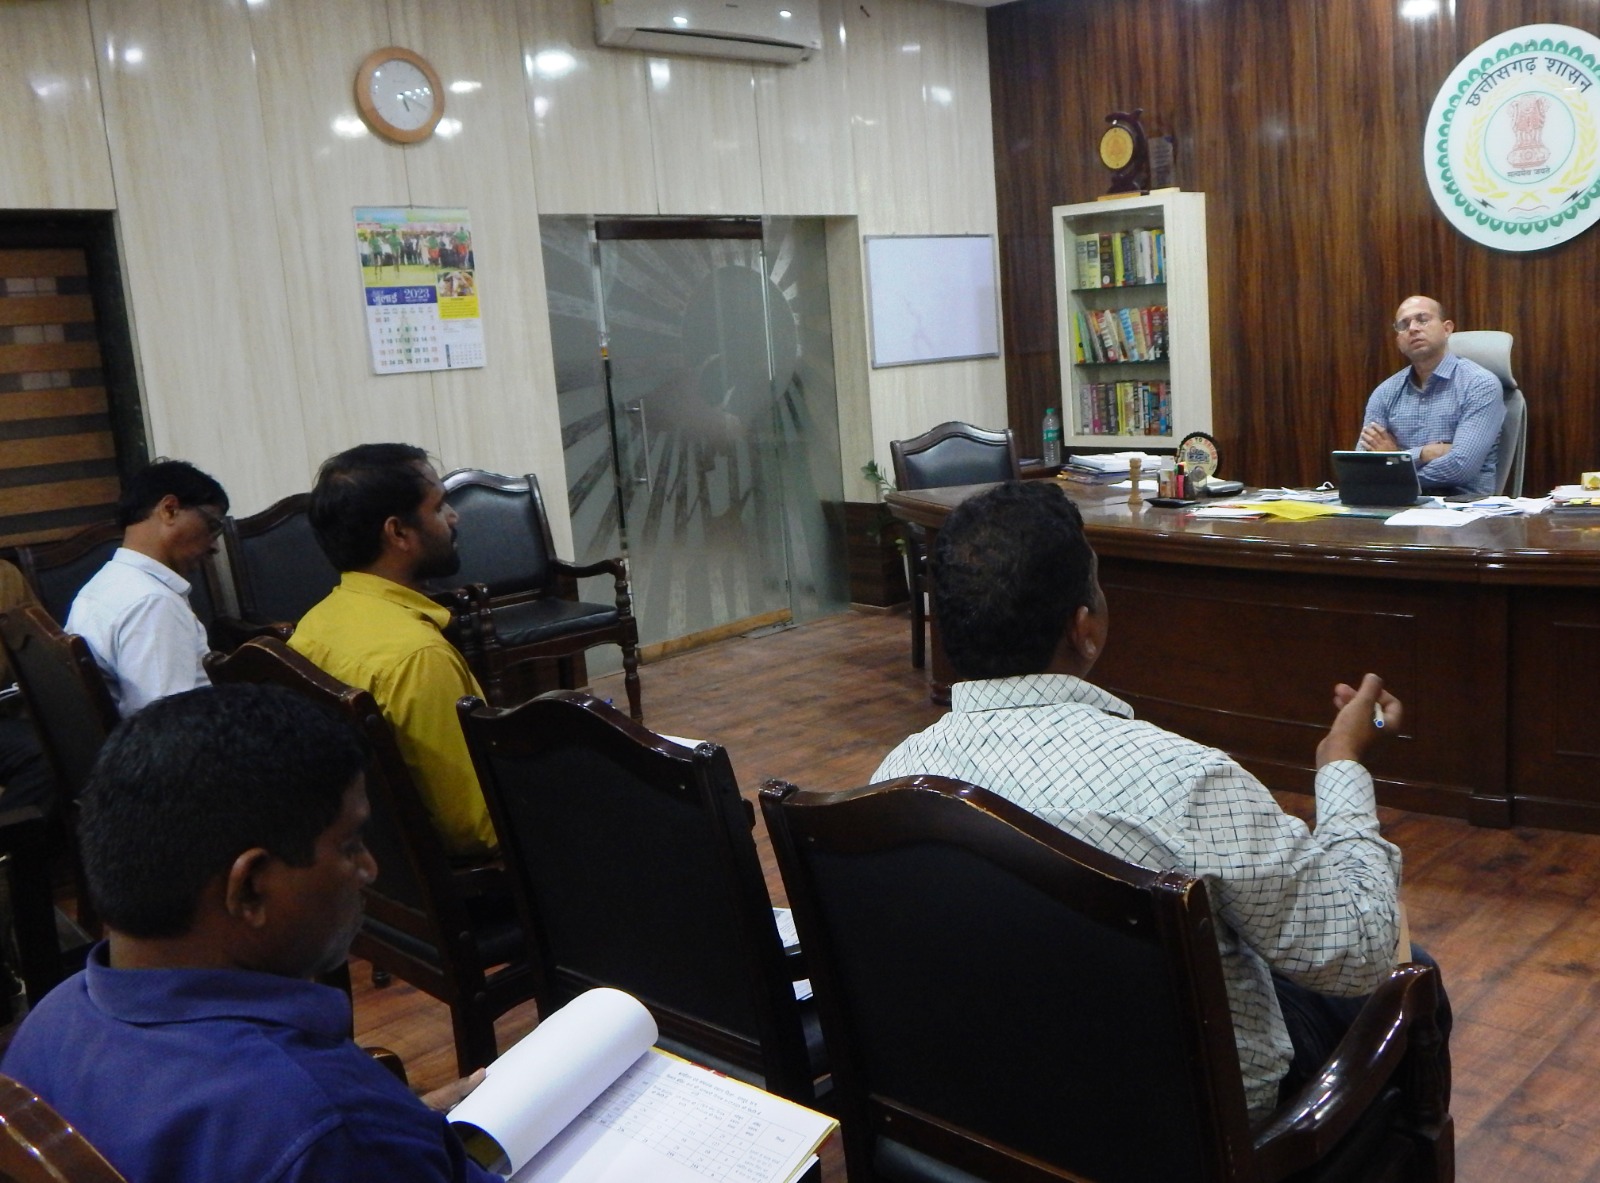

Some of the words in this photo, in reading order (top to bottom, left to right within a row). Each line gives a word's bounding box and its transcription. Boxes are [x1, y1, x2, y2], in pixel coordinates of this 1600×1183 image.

[1465, 57, 1538, 107] छत्तीसगढ़
[1544, 57, 1593, 94] शासन
[403, 288, 430, 299] 2023
